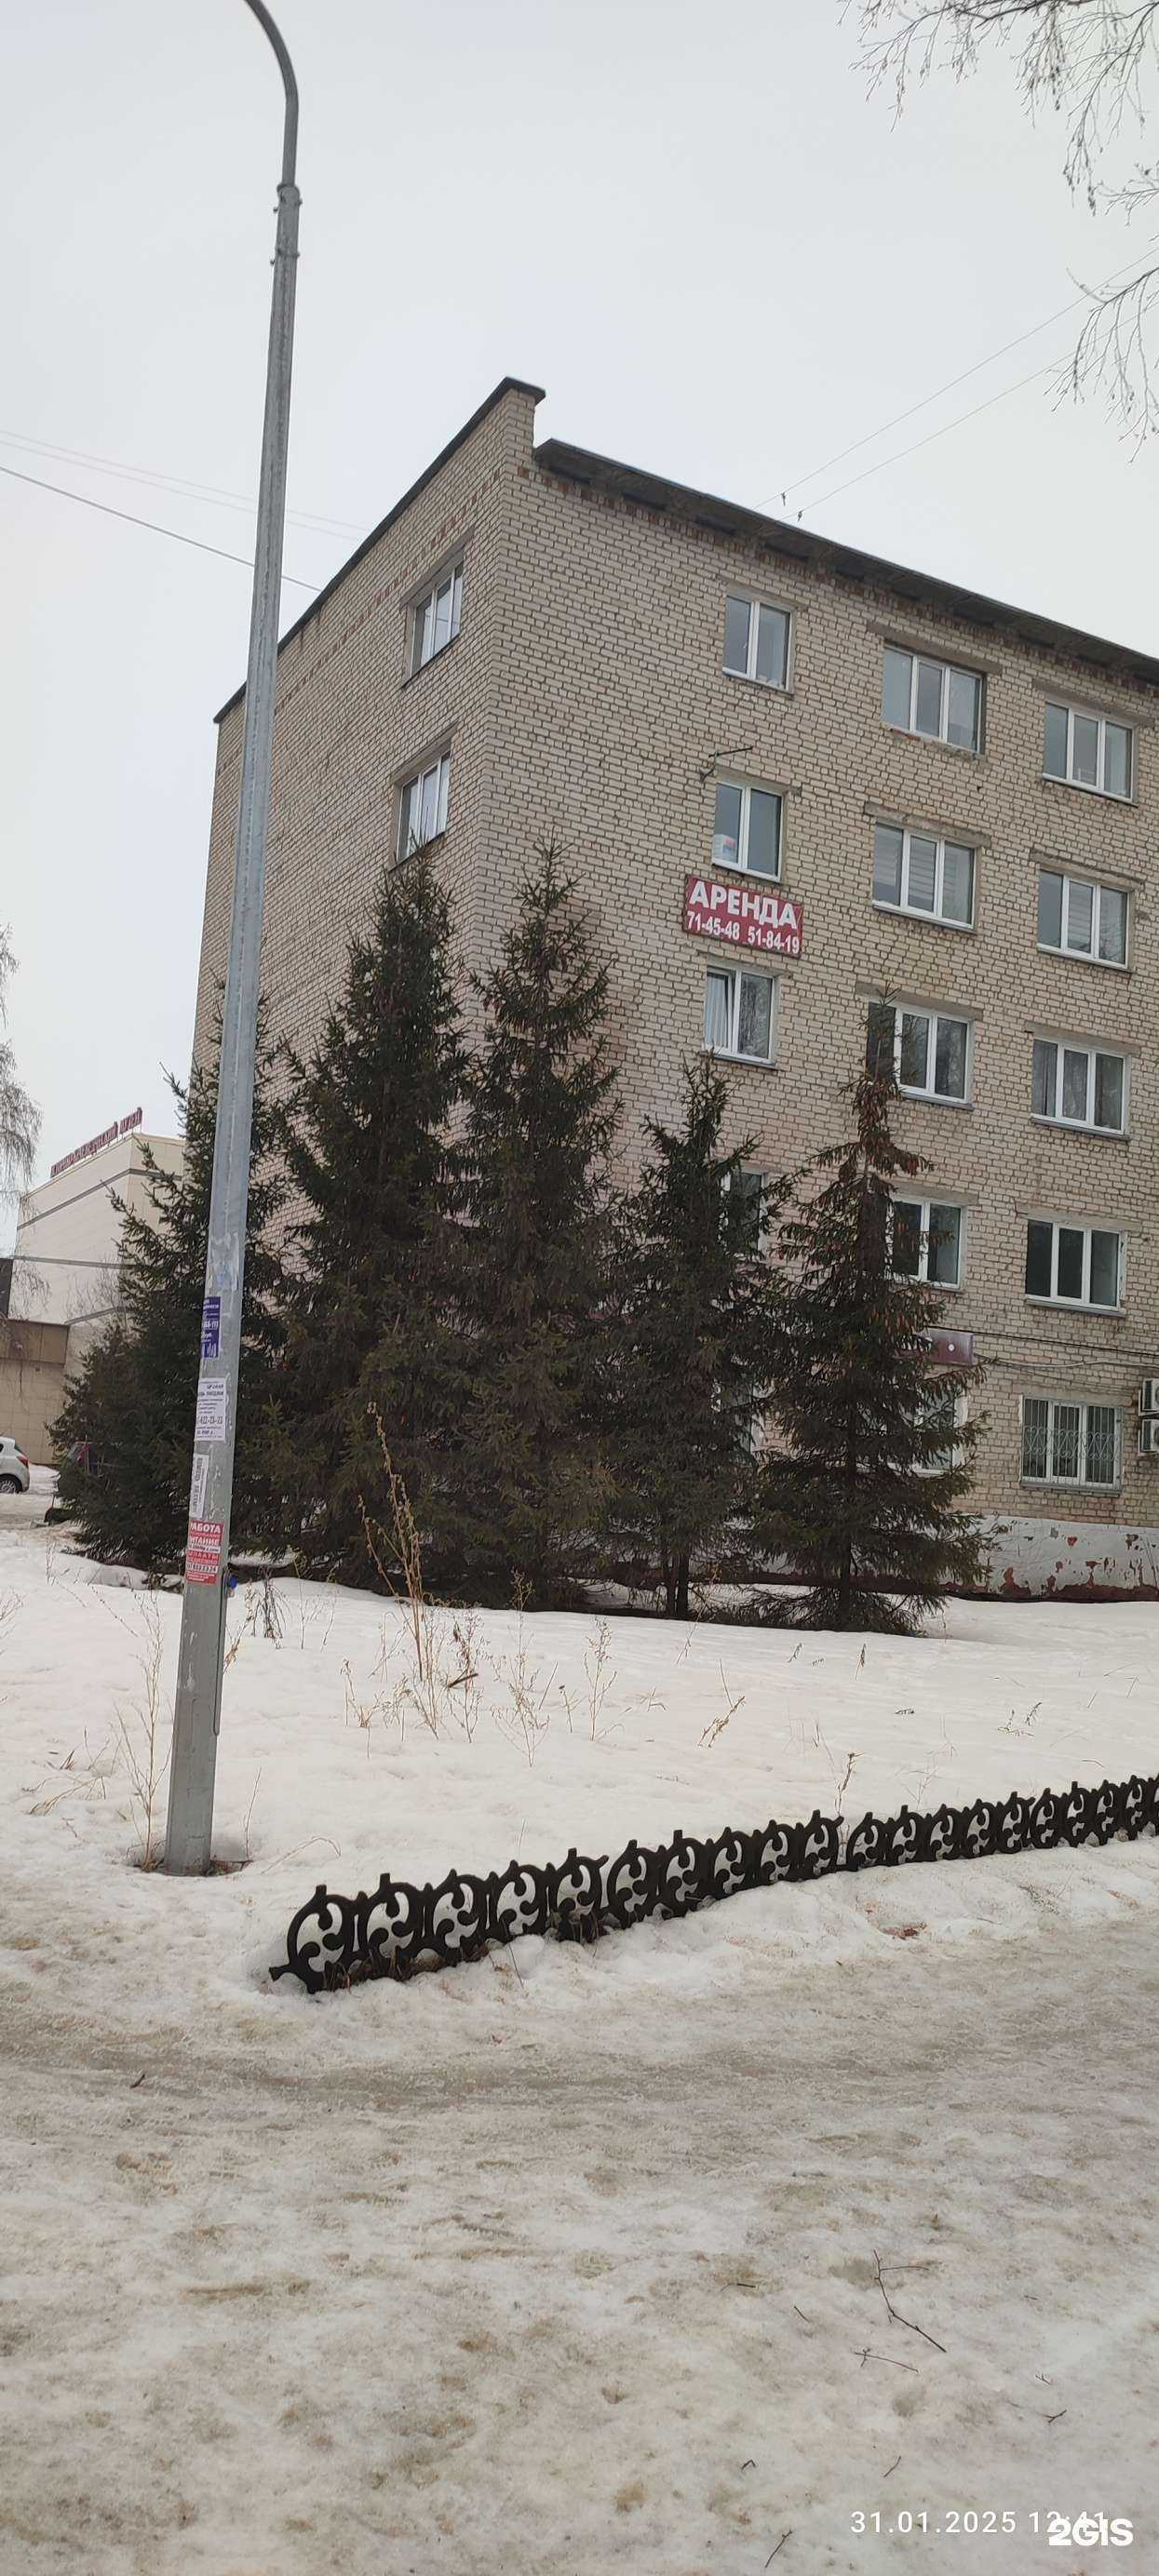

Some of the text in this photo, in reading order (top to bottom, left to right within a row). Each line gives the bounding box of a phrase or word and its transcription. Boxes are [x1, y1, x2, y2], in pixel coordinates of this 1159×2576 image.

[689, 880, 798, 930] АРЕНДА
[687, 910, 800, 954] 71-45-48 51-84-19
